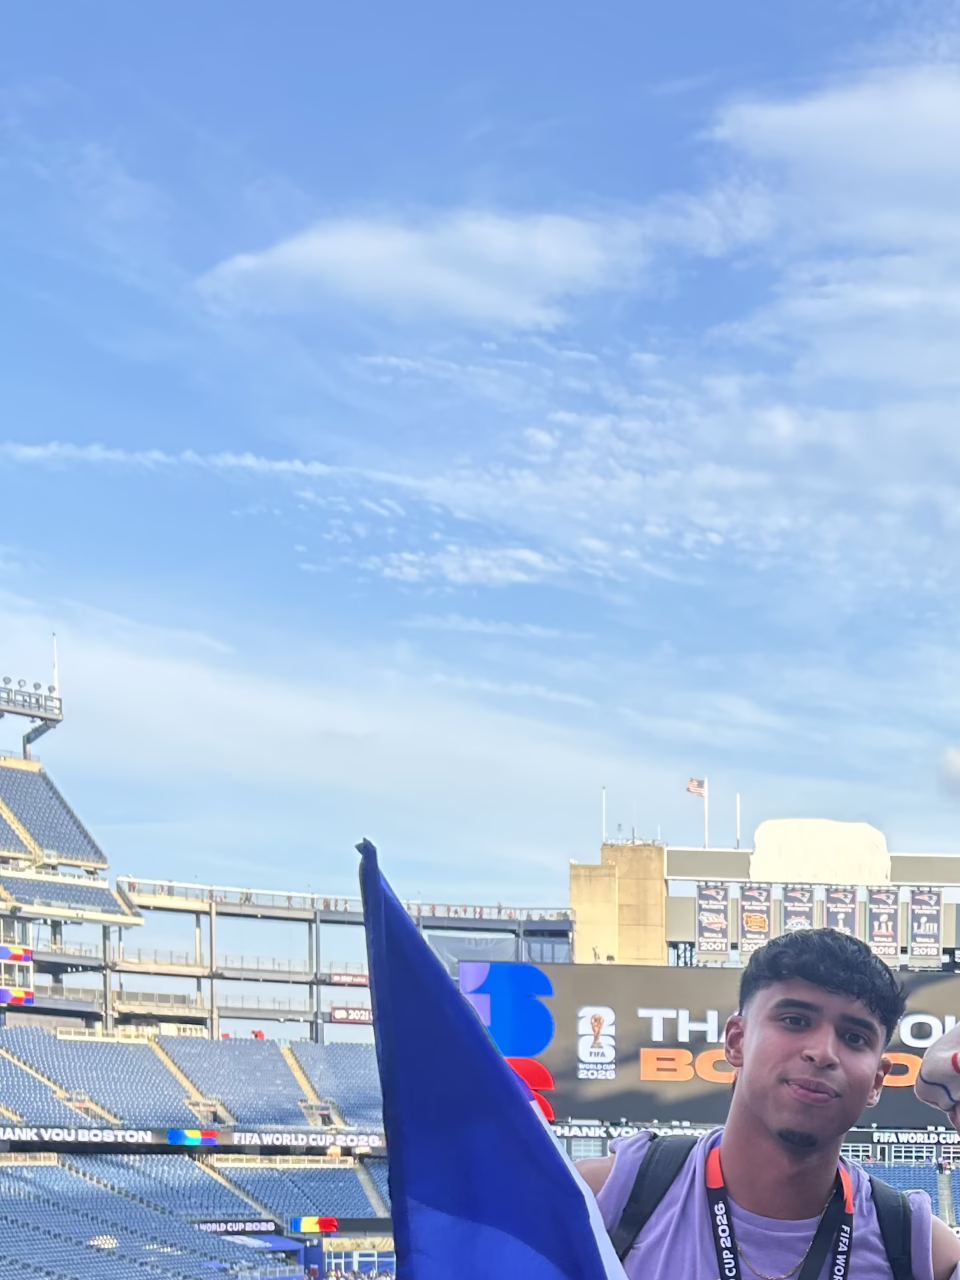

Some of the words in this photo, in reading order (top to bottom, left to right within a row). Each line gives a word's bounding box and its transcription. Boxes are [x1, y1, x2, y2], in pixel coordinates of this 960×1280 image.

[700, 942, 726, 951] 2001
[872, 946, 896, 955] 2016
[913, 947, 938, 955] 2018
[348, 1009, 369, 1021] 2021
[589, 1050, 606, 1058] FIFA
[578, 1069, 616, 1080] 2026
[41, 1128, 75, 1142] YOU
[77, 1129, 152, 1143] BOSTON
[551, 1126, 607, 1138] THANK
[233, 1132, 260, 1145] FIFA
[260, 1133, 308, 1146] WORLD
[308, 1134, 334, 1146] CUP
[335, 1135, 379, 1147] 2026
[873, 1132, 900, 1143] FIFA
[900, 1132, 939, 1144] WORLD
[939, 1133, 960, 1145] CUP
[227, 1222, 244, 1231] CUP
[245, 1222, 275, 1231] 2026
[714, 1203, 732, 1248] 2026
[837, 1224, 851, 1252] FIFA
[722, 1249, 736, 1277] CUP
